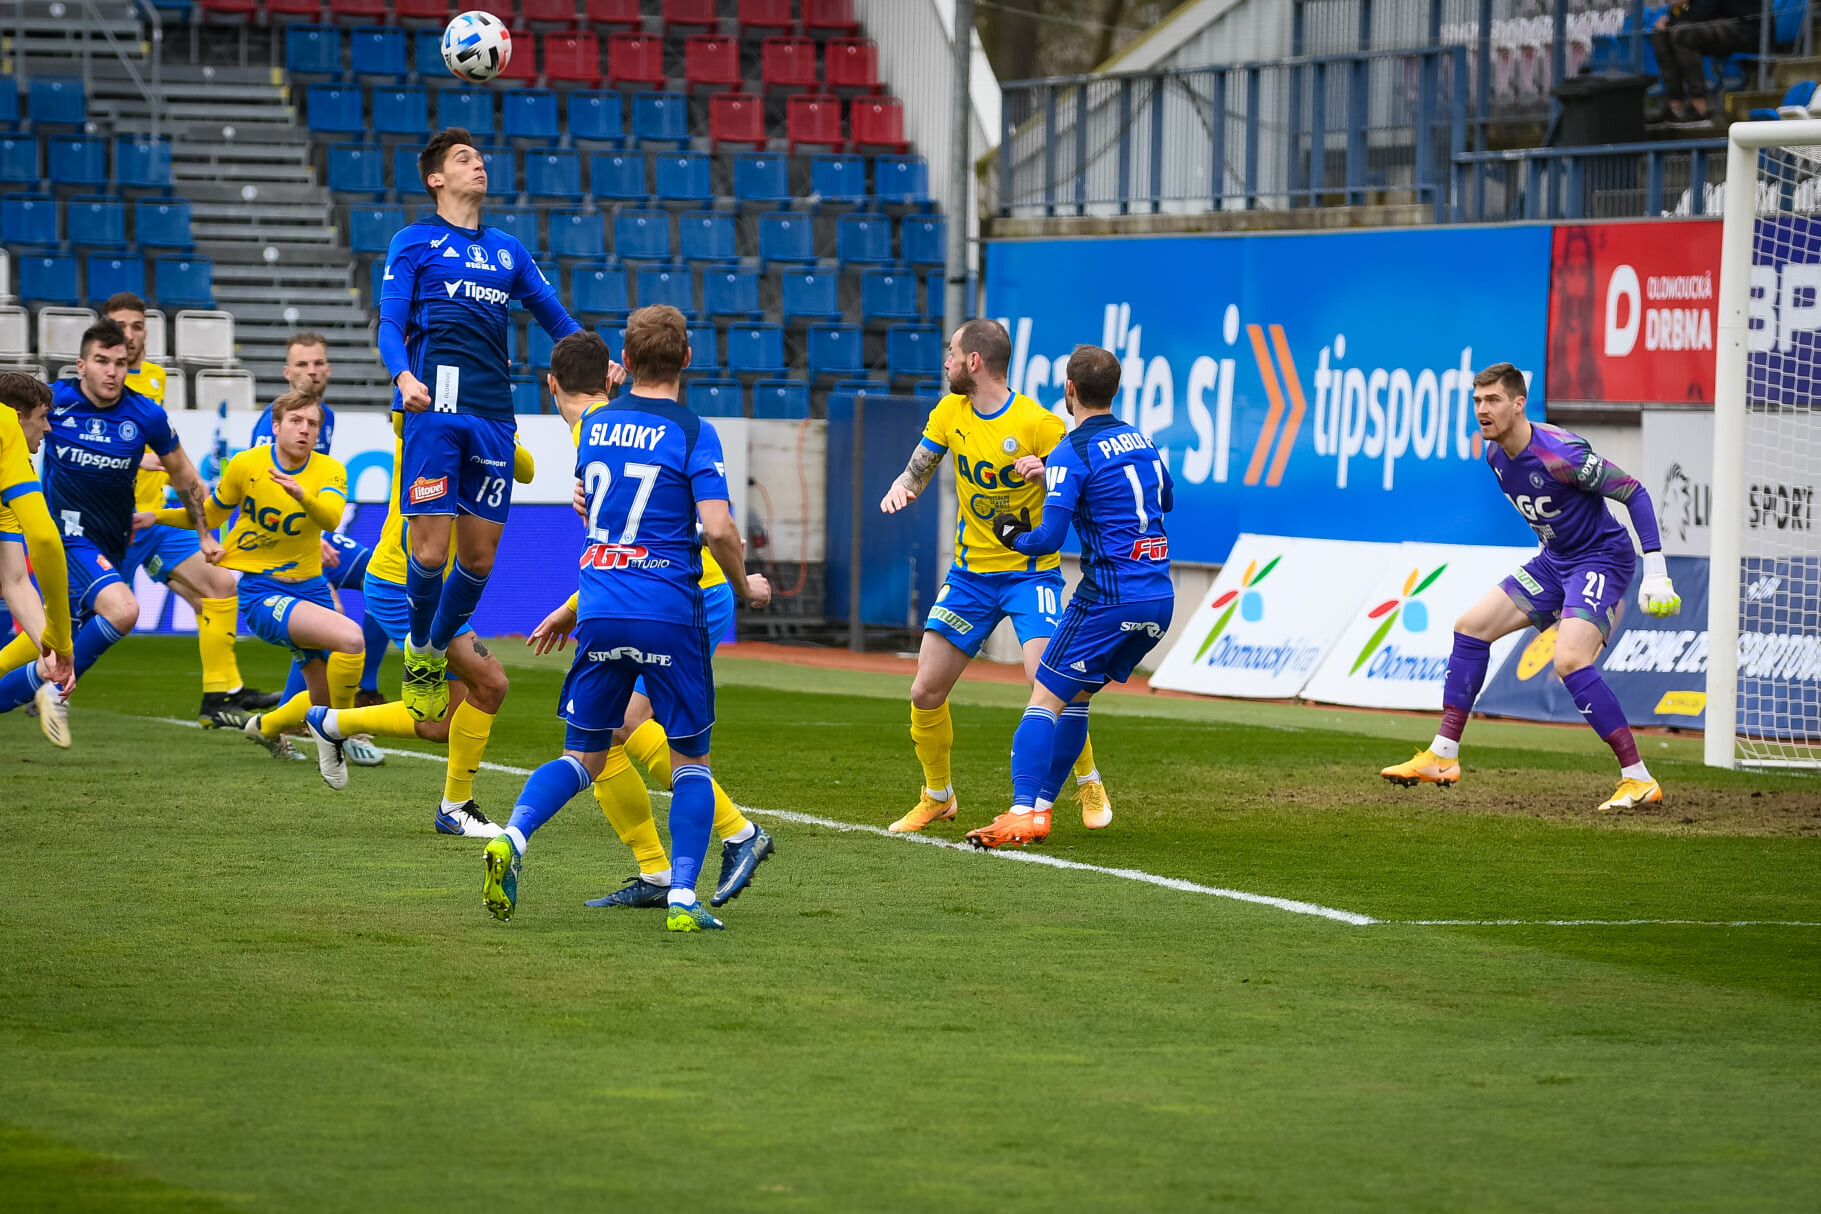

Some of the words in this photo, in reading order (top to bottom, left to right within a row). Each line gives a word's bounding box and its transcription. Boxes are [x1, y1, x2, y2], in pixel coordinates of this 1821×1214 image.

[464, 261, 497, 272] SIGMA
[1646, 270, 1713, 301] OLOMOUCKÁ
[1645, 308, 1712, 351] DRBNA
[1182, 303, 1240, 484] si
[79, 433, 111, 443] SIGMA
[589, 423, 667, 451] SLADKÝ
[1098, 432, 1147, 459] PABLO
[70, 448, 131, 469] Tipsport
[958, 454, 1025, 490] AGC
[415, 481, 444, 500] Litovel
[475, 476, 506, 508] 13
[585, 460, 661, 545] 27
[1123, 460, 1165, 534] 11
[243, 495, 306, 536] AGC
[1750, 484, 1813, 529] SPORT
[631, 558, 670, 569] STUDIO
[1035, 585, 1056, 615] 10
[1582, 571, 1606, 600] 21
